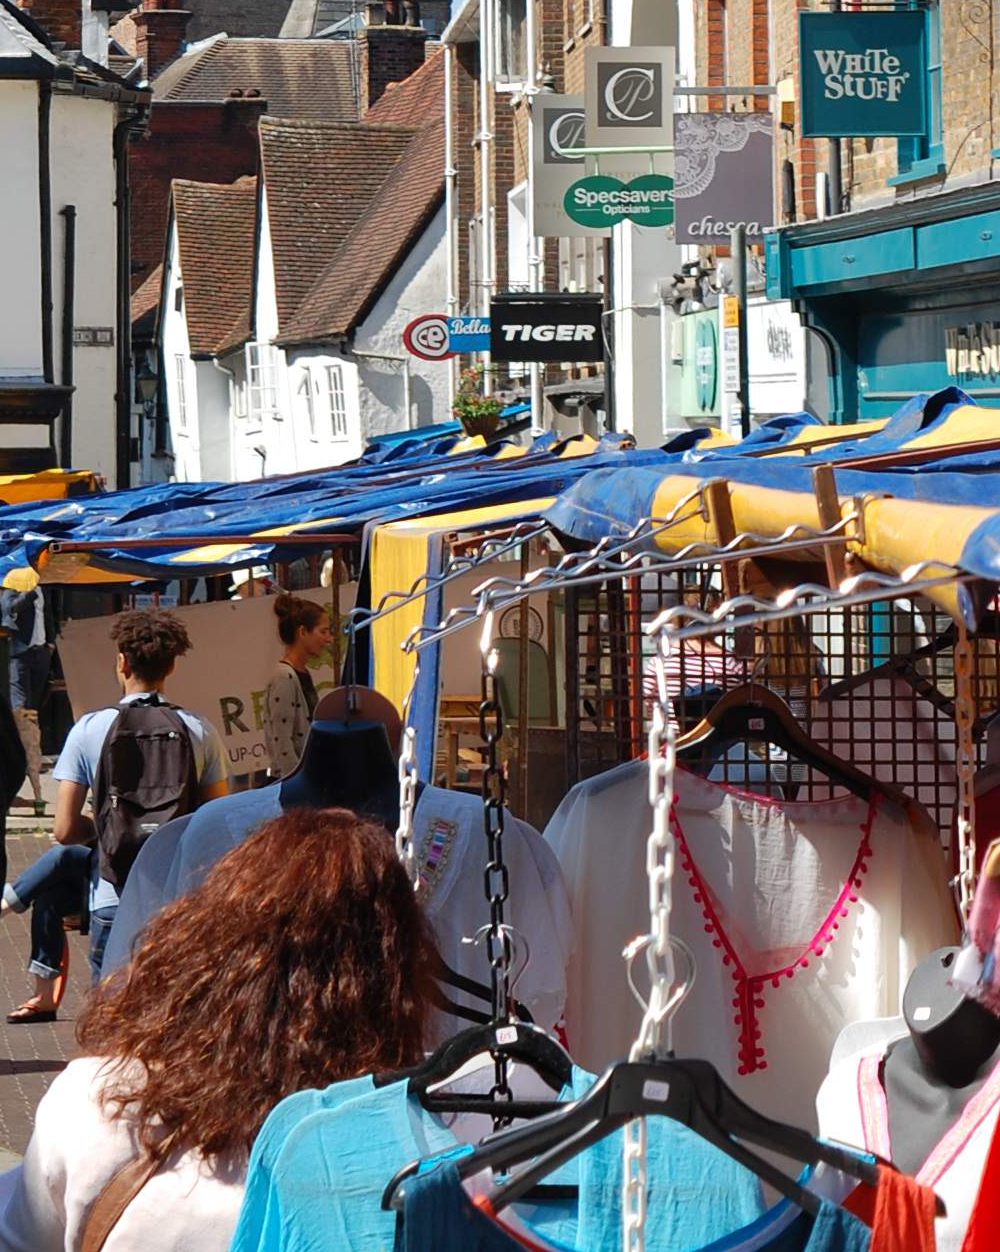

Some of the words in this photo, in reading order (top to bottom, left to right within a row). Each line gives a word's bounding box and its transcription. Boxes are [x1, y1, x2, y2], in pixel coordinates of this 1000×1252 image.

[574, 187, 675, 207] Specsavers
[602, 204, 651, 216] Opticians
[687, 215, 760, 236] chesca
[501, 324, 596, 342] TIGER
